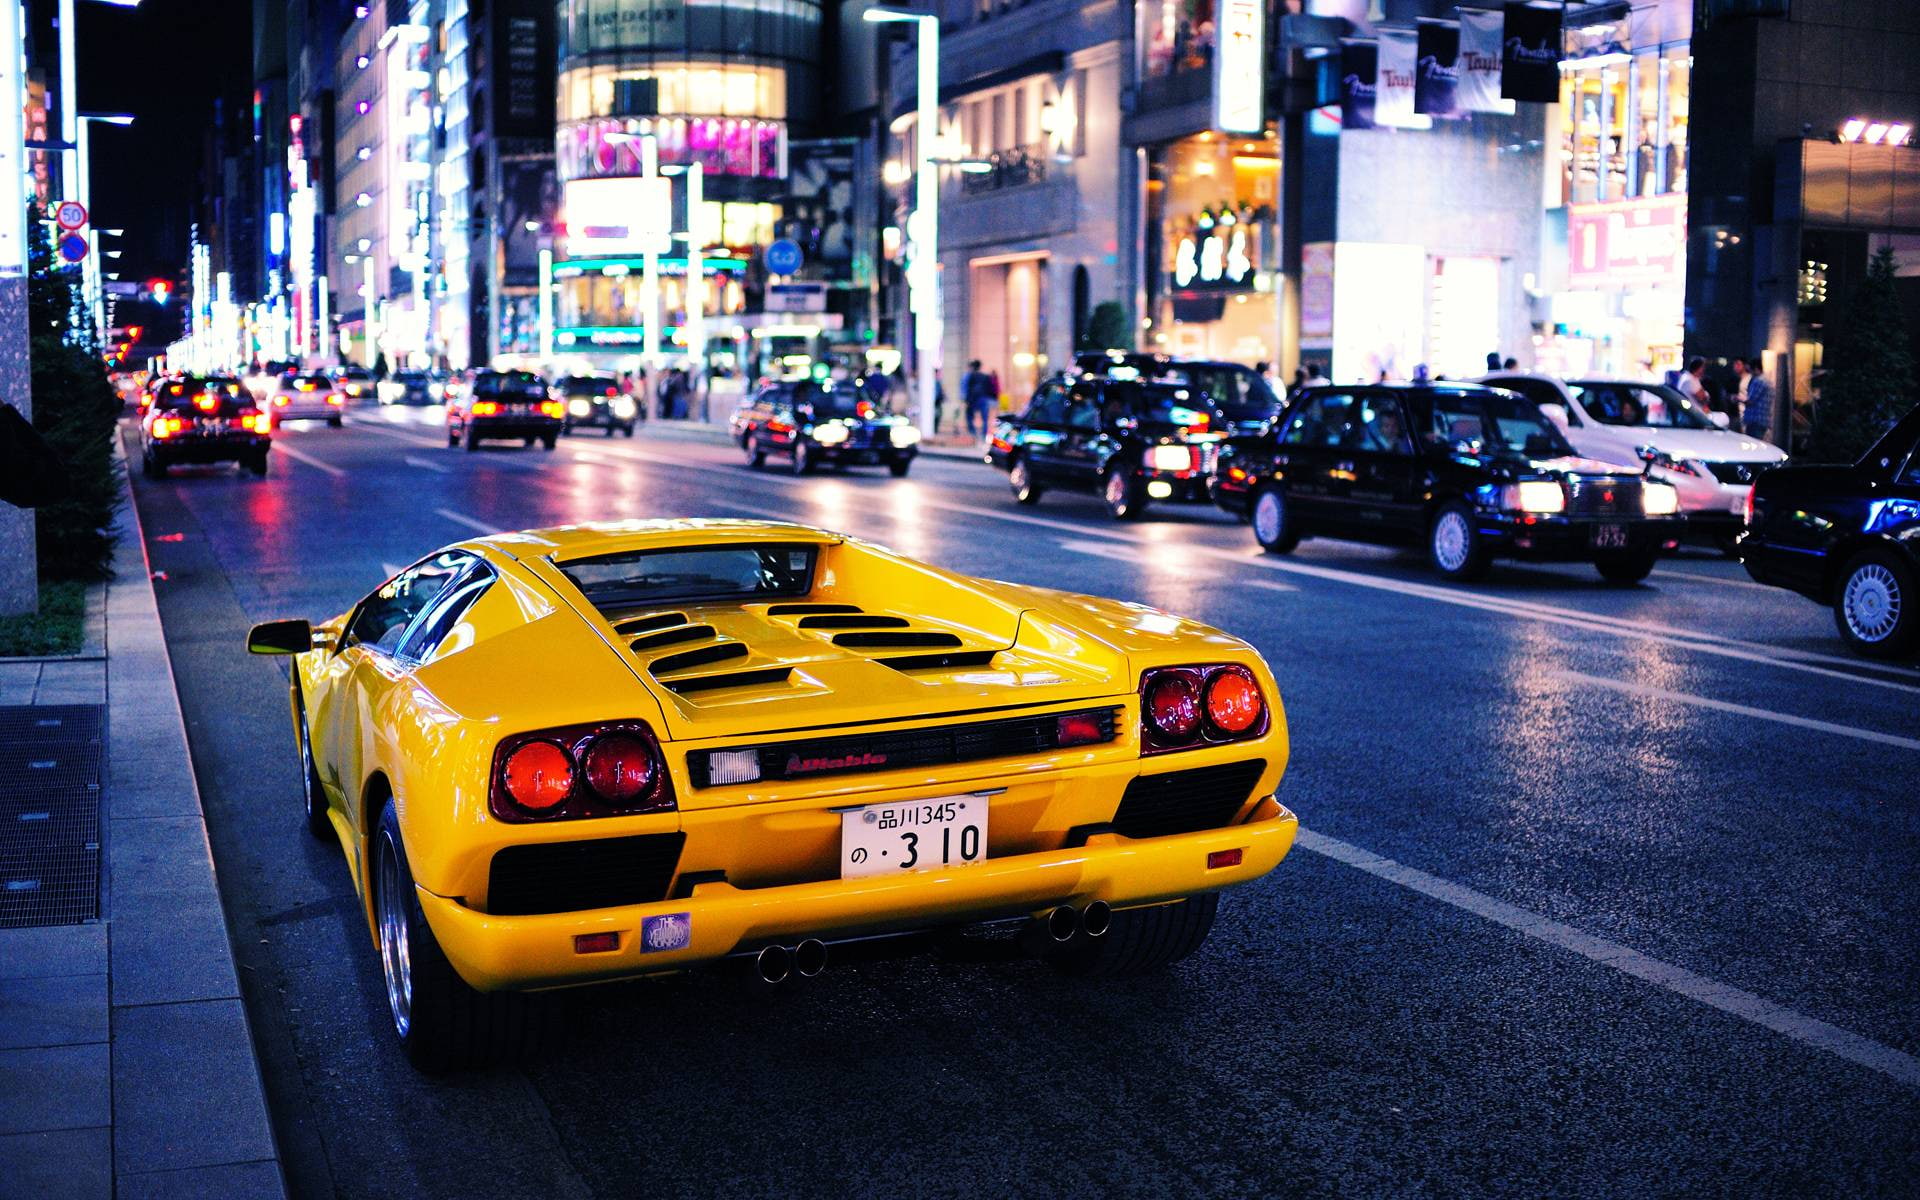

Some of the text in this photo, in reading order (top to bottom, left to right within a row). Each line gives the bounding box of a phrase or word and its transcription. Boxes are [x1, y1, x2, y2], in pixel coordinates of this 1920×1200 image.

[1505, 36, 1557, 61] Fender
[62, 207, 81, 222] 50
[784, 752, 888, 775] Diablo
[850, 847, 868, 864] の
[659, 916, 675, 929] THE
